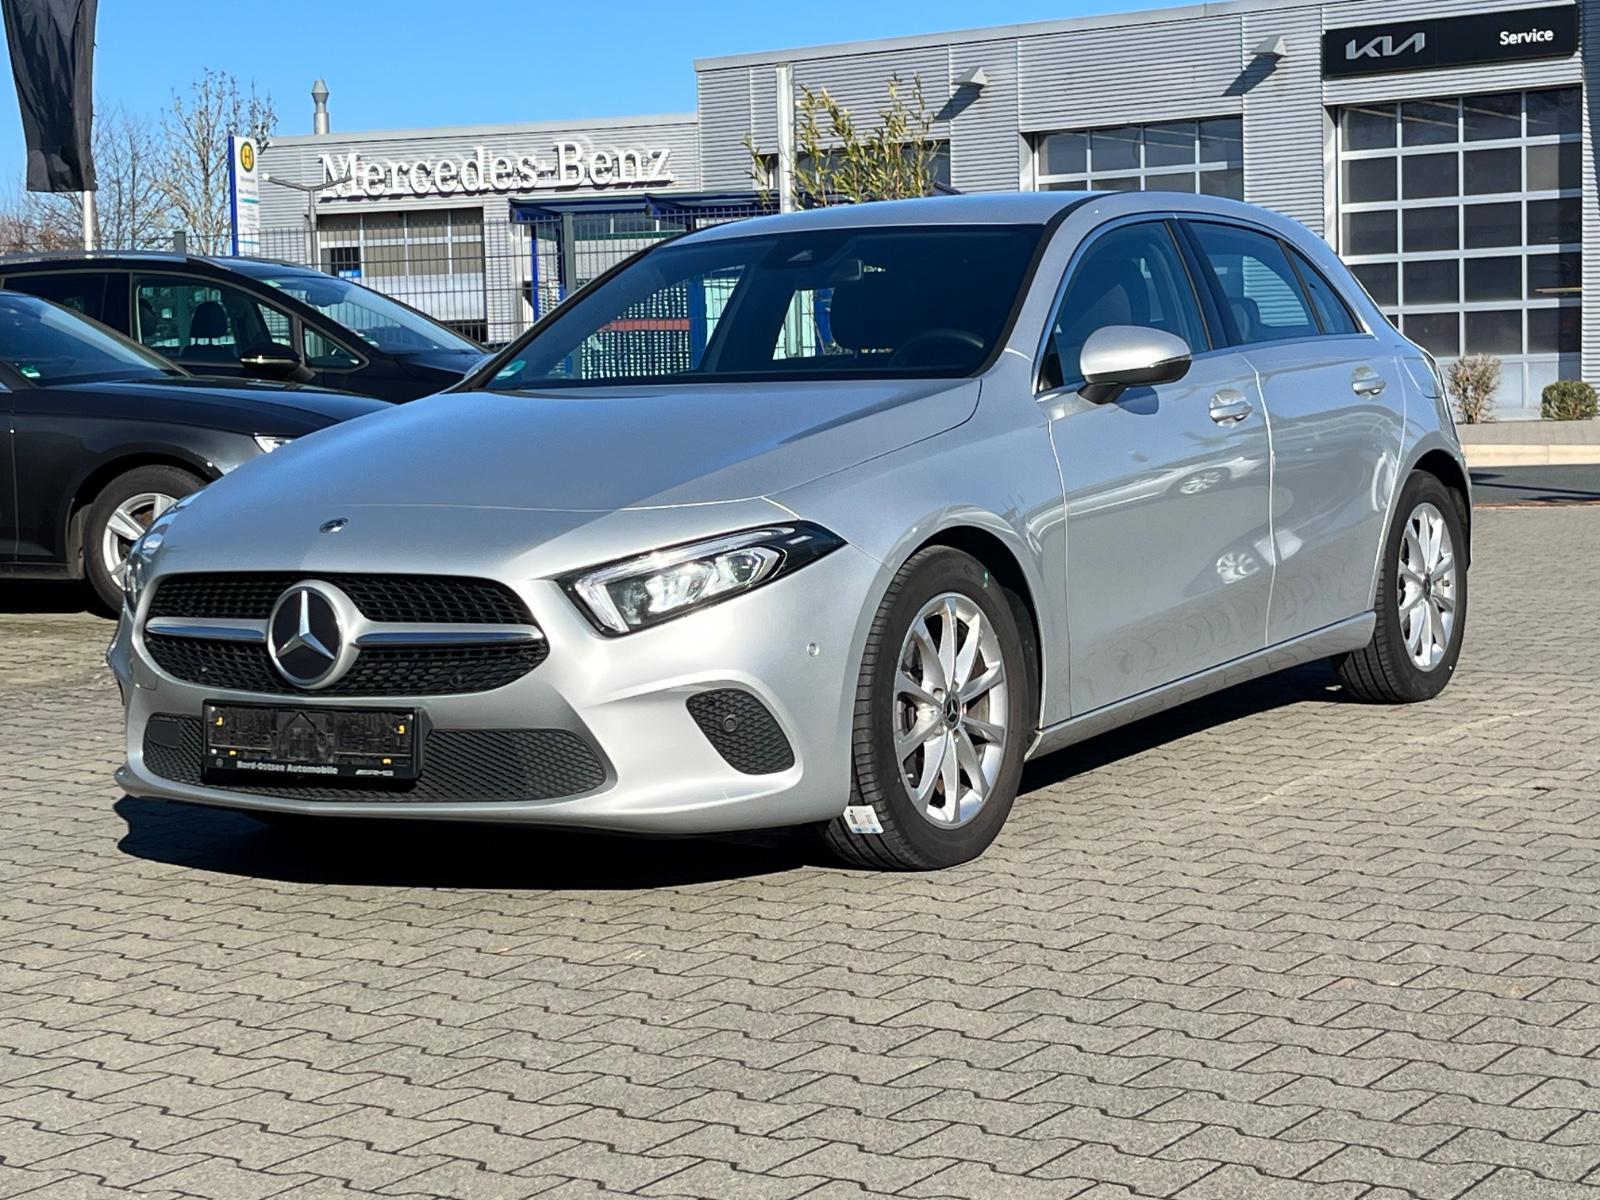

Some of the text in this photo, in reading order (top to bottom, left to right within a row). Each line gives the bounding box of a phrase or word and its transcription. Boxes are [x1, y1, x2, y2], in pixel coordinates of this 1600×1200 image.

[1499, 28, 1554, 45] Service
[319, 140, 674, 199] Mercedes-Benz
[286, 764, 339, 775] Automobile
